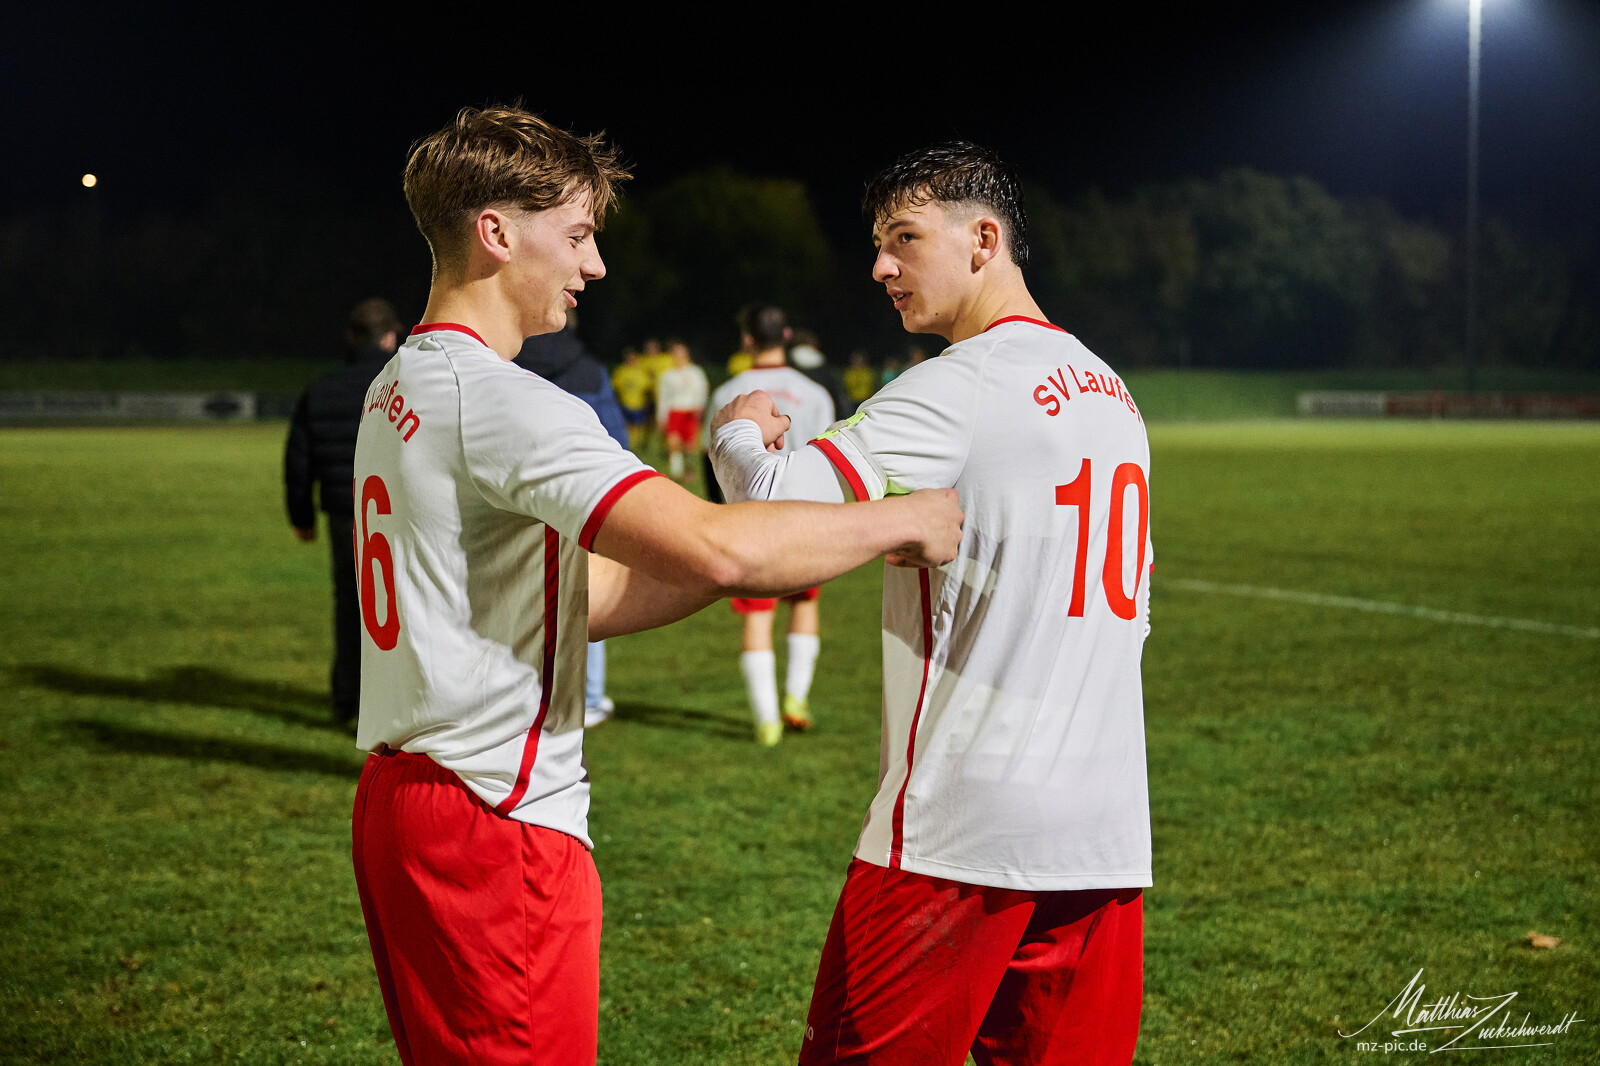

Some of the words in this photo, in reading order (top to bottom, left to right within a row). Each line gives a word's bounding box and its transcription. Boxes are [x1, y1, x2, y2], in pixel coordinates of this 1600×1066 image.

[1033, 368, 1070, 417] SV
[1067, 364, 1141, 422] Laufe
[353, 475, 400, 651] 6
[1055, 458, 1148, 621] 10
